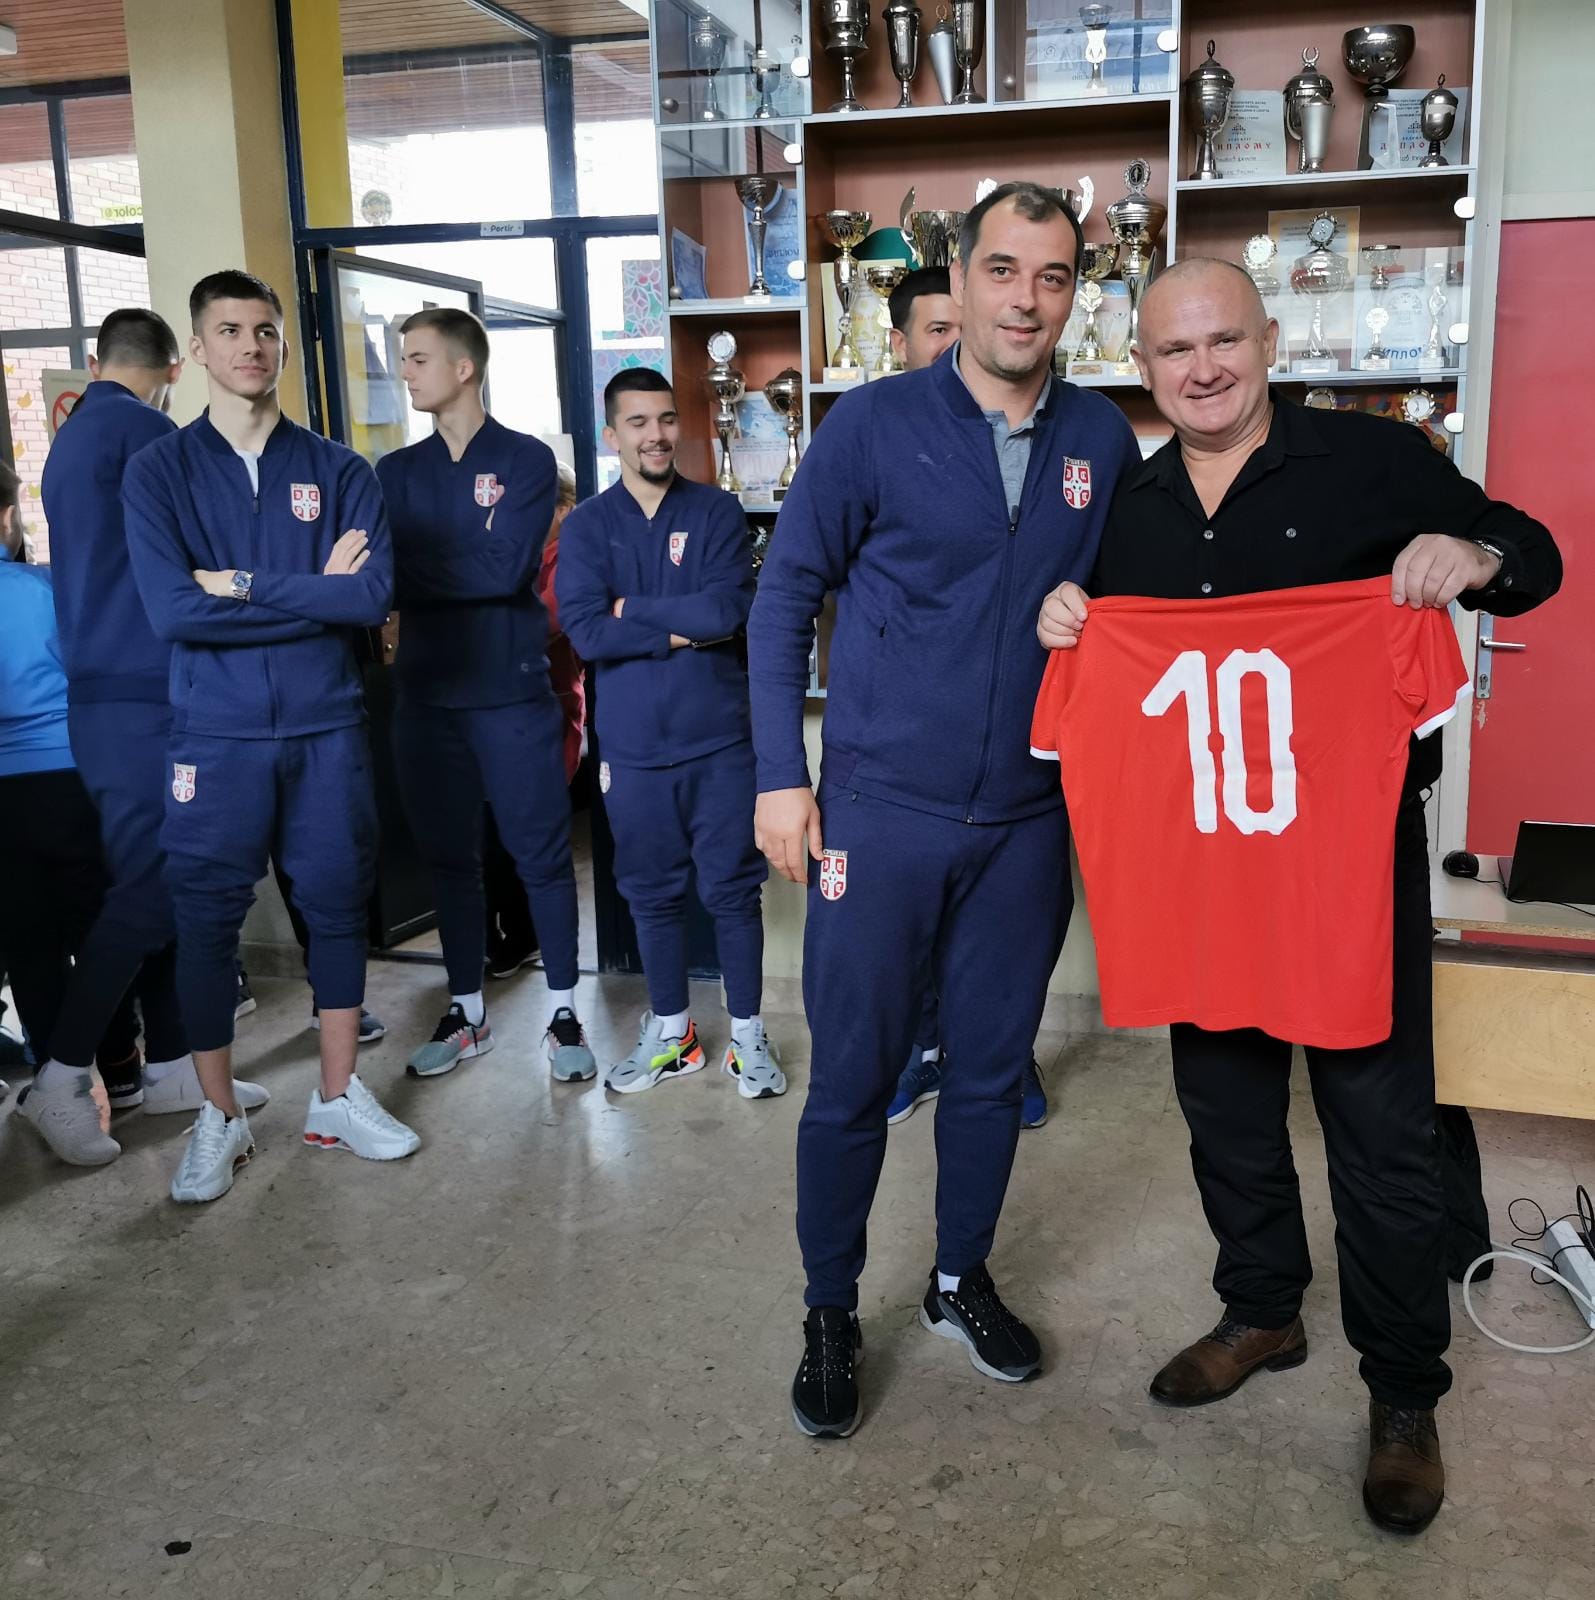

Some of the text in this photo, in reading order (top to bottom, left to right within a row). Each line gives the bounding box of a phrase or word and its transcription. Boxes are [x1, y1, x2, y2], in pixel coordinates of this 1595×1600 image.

[1217, 142, 1271, 151] ИПЛОМУ
[1380, 140, 1448, 151] ДПЛОУ
[1382, 346, 1422, 360] ИПЛО
[1141, 648, 1298, 836] 10
